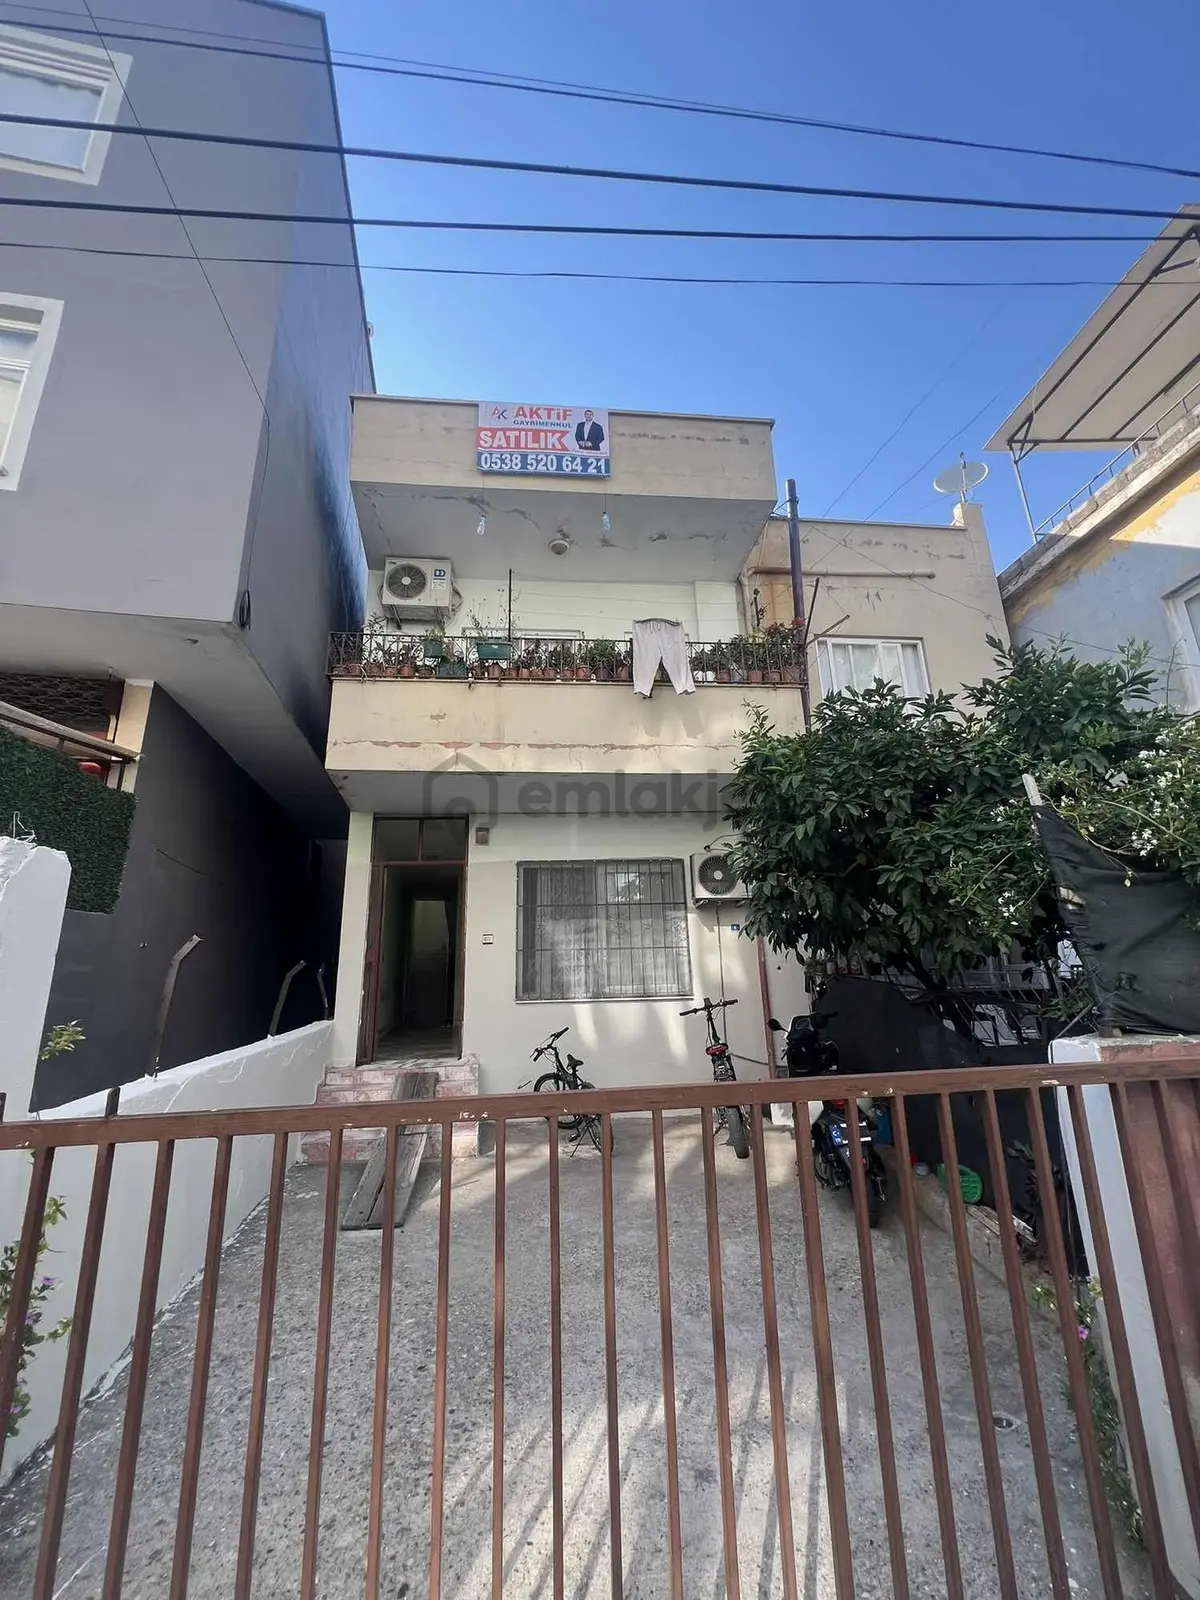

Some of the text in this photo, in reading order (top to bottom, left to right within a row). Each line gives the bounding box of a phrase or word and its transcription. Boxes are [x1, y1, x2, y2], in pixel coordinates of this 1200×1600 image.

[479, 430, 562, 449] SATILIK
[480, 453, 605, 473] 0538 520 64 21
